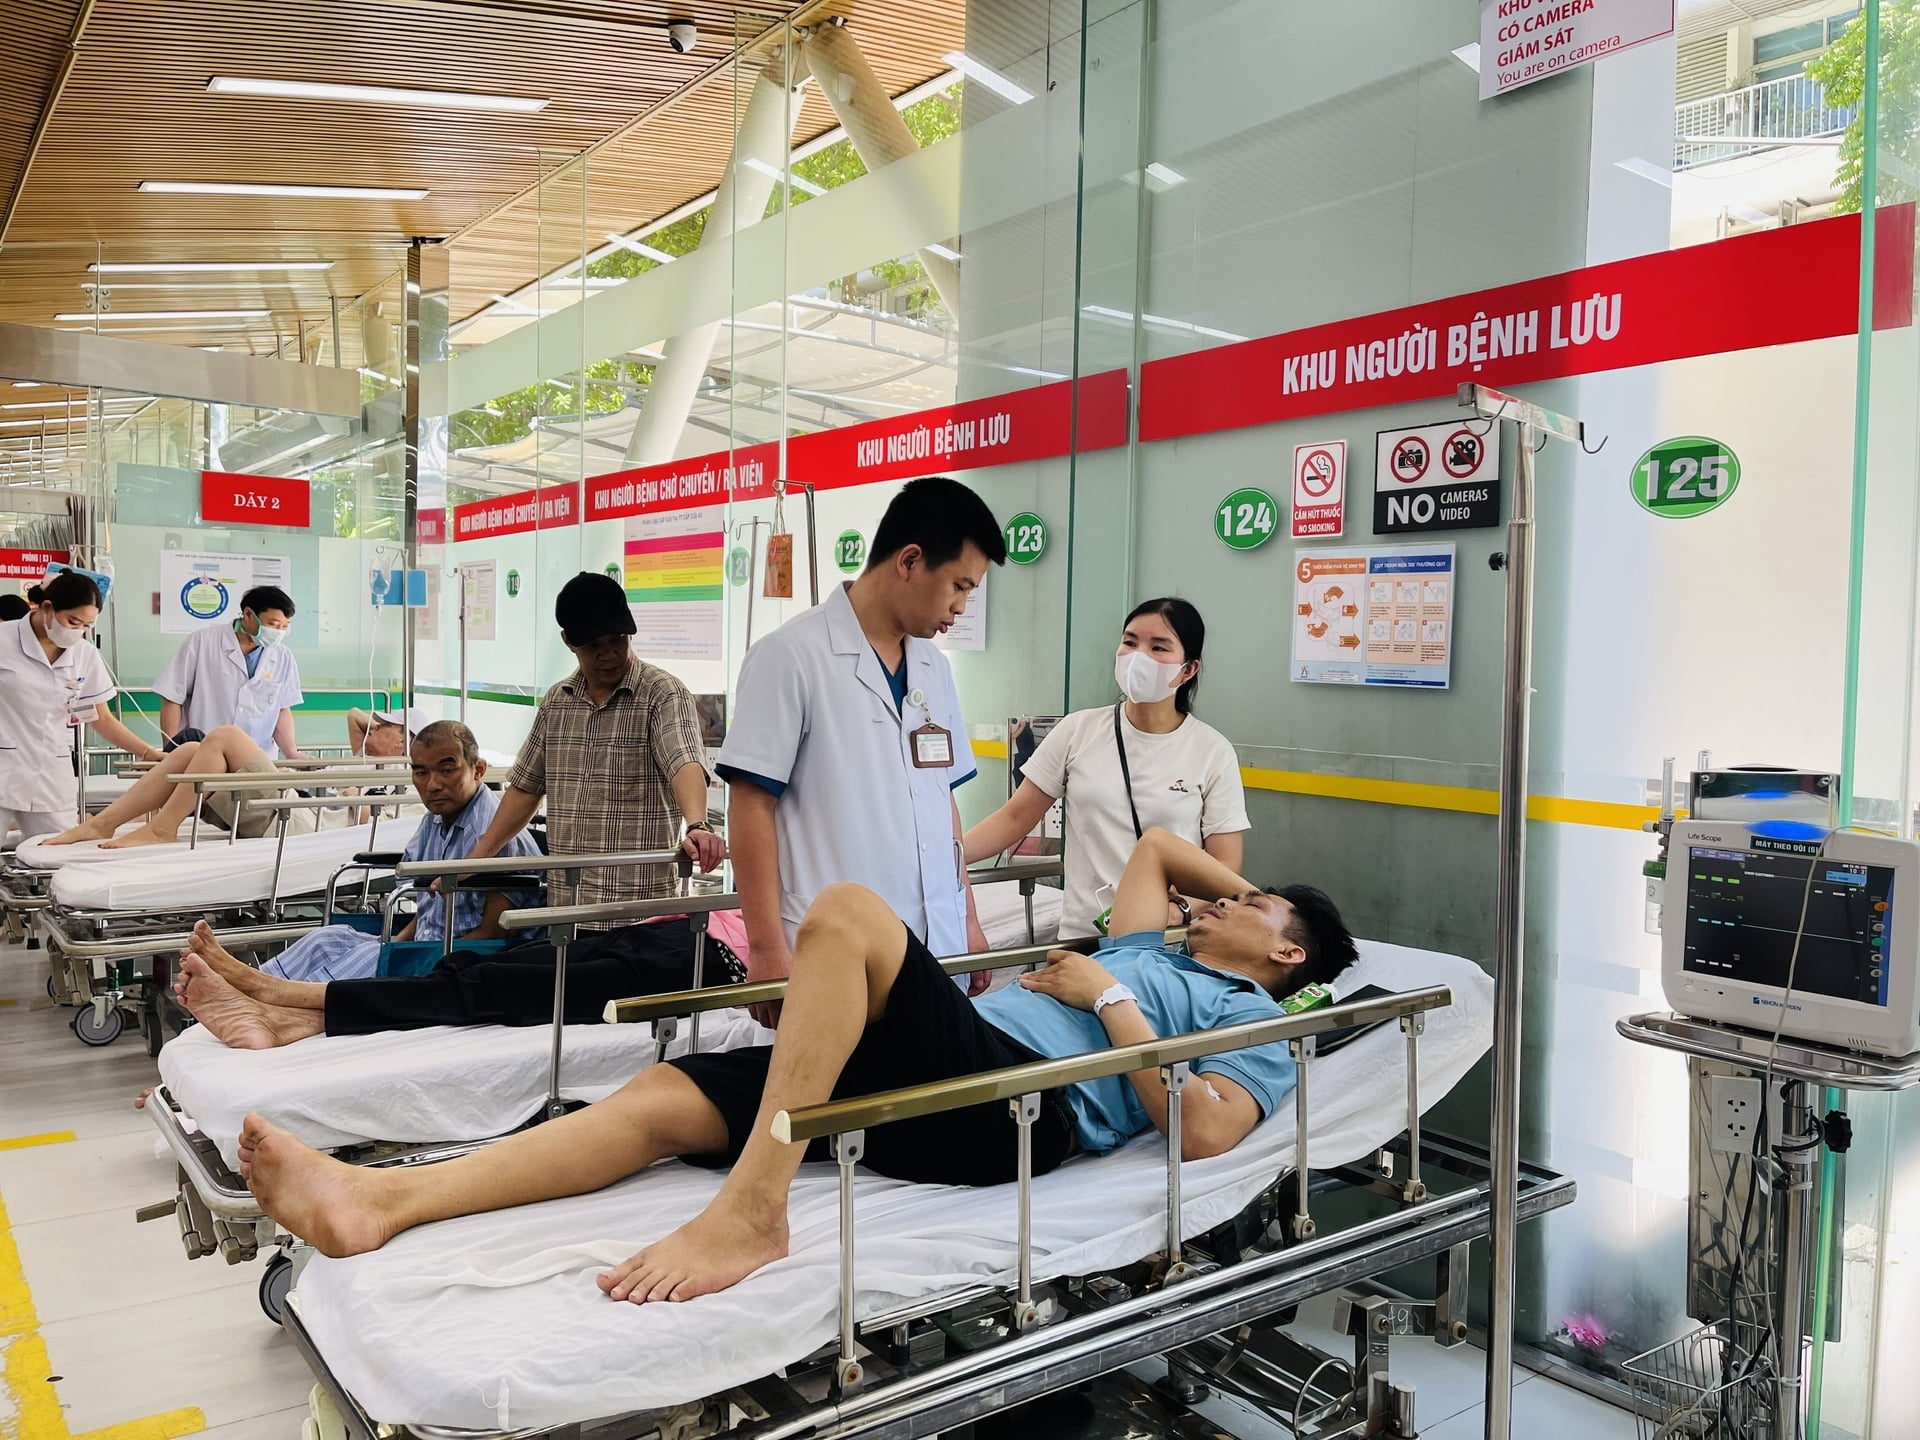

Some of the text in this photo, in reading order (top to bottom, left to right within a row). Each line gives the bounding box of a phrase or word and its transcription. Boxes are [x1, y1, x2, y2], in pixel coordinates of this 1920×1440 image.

[1498, 0, 1531, 18] KHU
[1498, 0, 1594, 42] CÓ CAMERA
[1497, 28, 1574, 67] GIÁM SÁT
[1497, 35, 1621, 86] You are on camera
[1283, 293, 1622, 395] KHU NGƯỜI BỆNH LƯU
[856, 412, 1011, 468] KHU NGƯỜI BỆNH LƯU
[595, 459, 763, 510] KHU NGƯỜI BỆNH CHỜ CHUYỂN / RA VIỆN
[1640, 455, 1729, 500] 125
[233, 491, 280, 509] DÃY 2
[1295, 506, 1341, 520] CẤM HÚT THUỐC
[1387, 488, 1488, 526] NO CAMERAS
[460, 516, 471, 533] KHU
[471, 509, 487, 531] NGƯỜI
[488, 508, 502, 531] BỆNH
[503, 503, 515, 526] CHỜ
[516, 497, 539, 524] CHUYỂN
[544, 501, 554, 519] RA
[554, 494, 570, 520] VIỆN
[1220, 502, 1272, 537] 124
[1440, 507, 1471, 521] VIDEO
[1006, 524, 1042, 553] 123
[1298, 522, 1335, 534] NO SMOKING
[837, 540, 863, 563] 122
[506, 575, 520, 592] 119
[1302, 562, 1311, 579] 5
[1701, 834, 1722, 842] Scope
[1755, 839, 1771, 848] MÁY
[1773, 842, 1791, 851] THEO
[1761, 999, 1802, 1011] NIHON KHDEN
